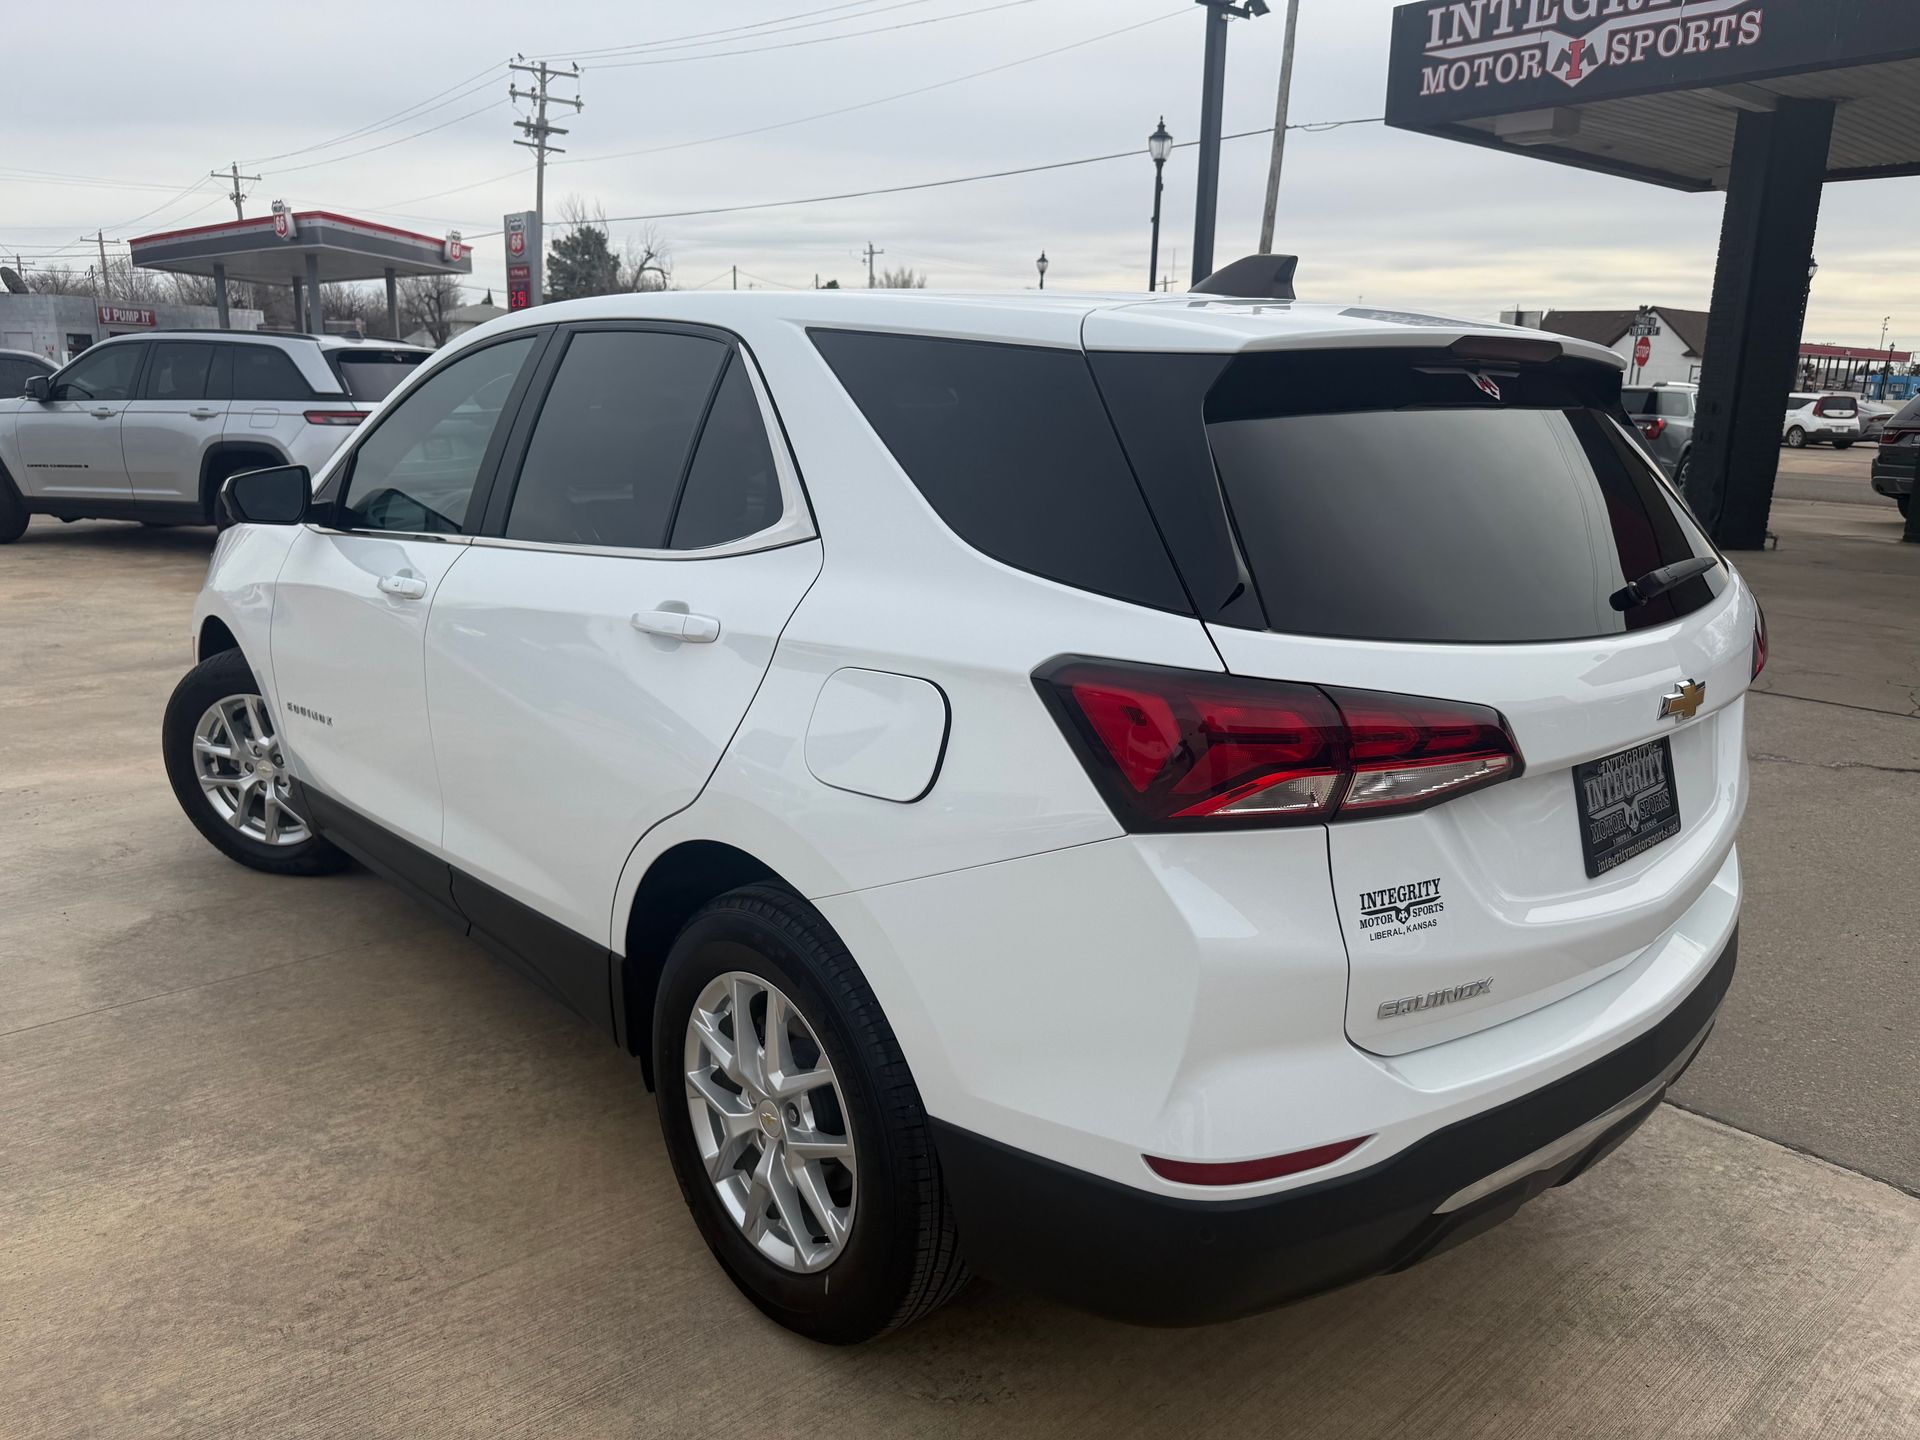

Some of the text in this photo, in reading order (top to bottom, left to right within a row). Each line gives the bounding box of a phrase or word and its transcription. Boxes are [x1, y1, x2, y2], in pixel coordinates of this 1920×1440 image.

[1420, 9, 1763, 96] MOTOR SPORTS
[276, 216, 285, 231] 66
[512, 232, 522, 250] 66
[102, 307, 150, 323] U PUMP IT
[1636, 345, 1650, 358] STOP
[1590, 788, 1670, 844] MOTOR SPORTS
[1597, 822, 1679, 872] integritymotorsports.net
[1359, 878, 1441, 910] INTEGRITY
[1359, 902, 1444, 929] MOTOR SPORTS
[1369, 919, 1437, 941] LIBERAL, KANSAS
[1377, 976, 1494, 1019] EQUINOX
